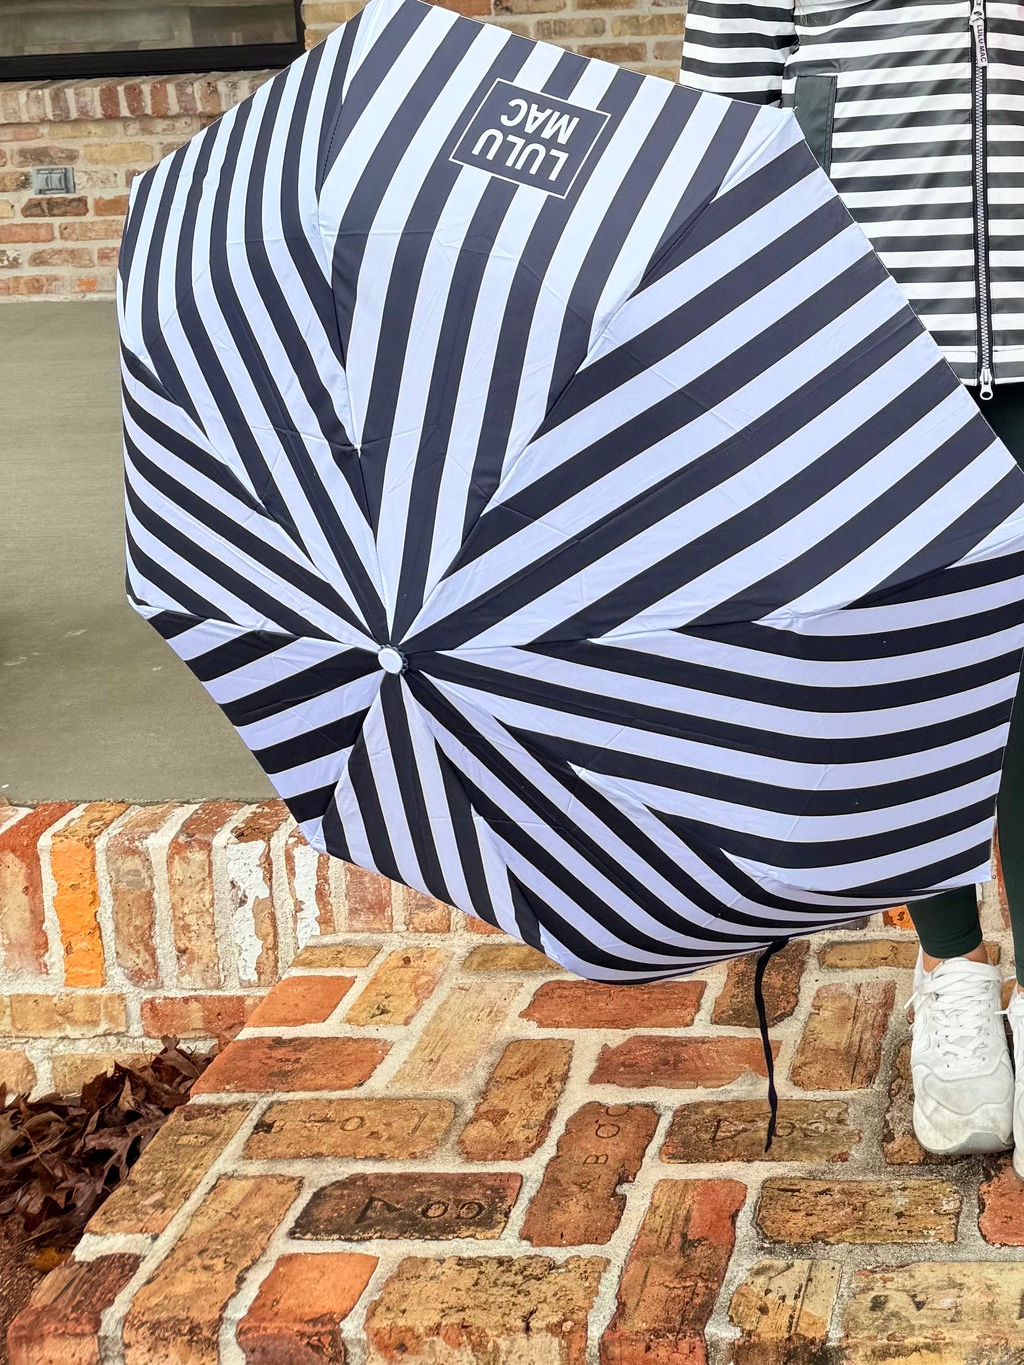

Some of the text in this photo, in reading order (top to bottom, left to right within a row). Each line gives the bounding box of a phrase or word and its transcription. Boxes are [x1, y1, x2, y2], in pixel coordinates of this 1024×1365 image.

[976, 24, 987, 63] LULU MAC
[500, 98, 580, 145] MAC
[471, 128, 570, 182] LULU
